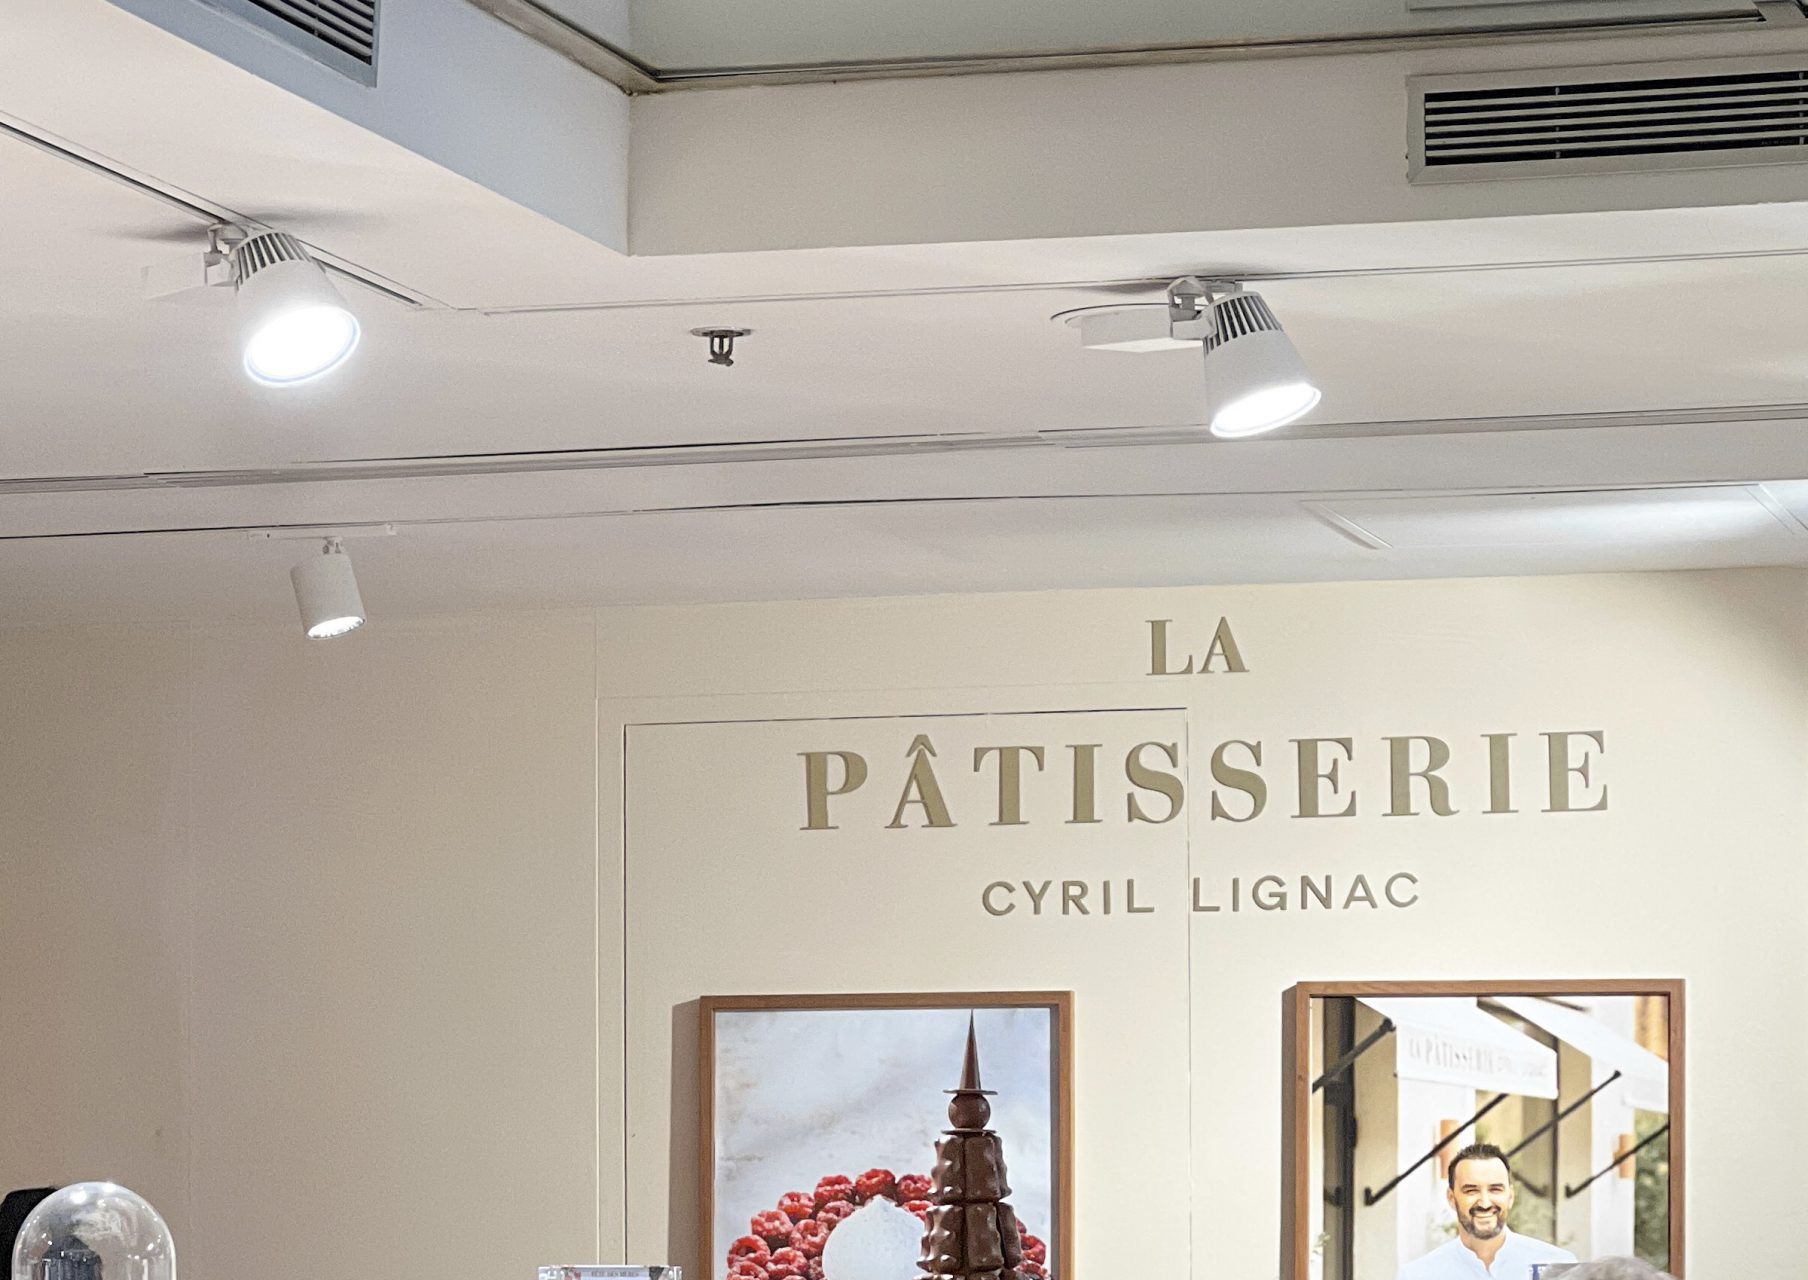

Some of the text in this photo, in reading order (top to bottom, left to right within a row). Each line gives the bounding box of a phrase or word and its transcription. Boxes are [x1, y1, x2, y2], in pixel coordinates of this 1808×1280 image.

[1145, 616, 1250, 677] LA
[796, 730, 1610, 832] PÂTISSERIE
[981, 871, 1420, 917] CYRIL LIGNAC
